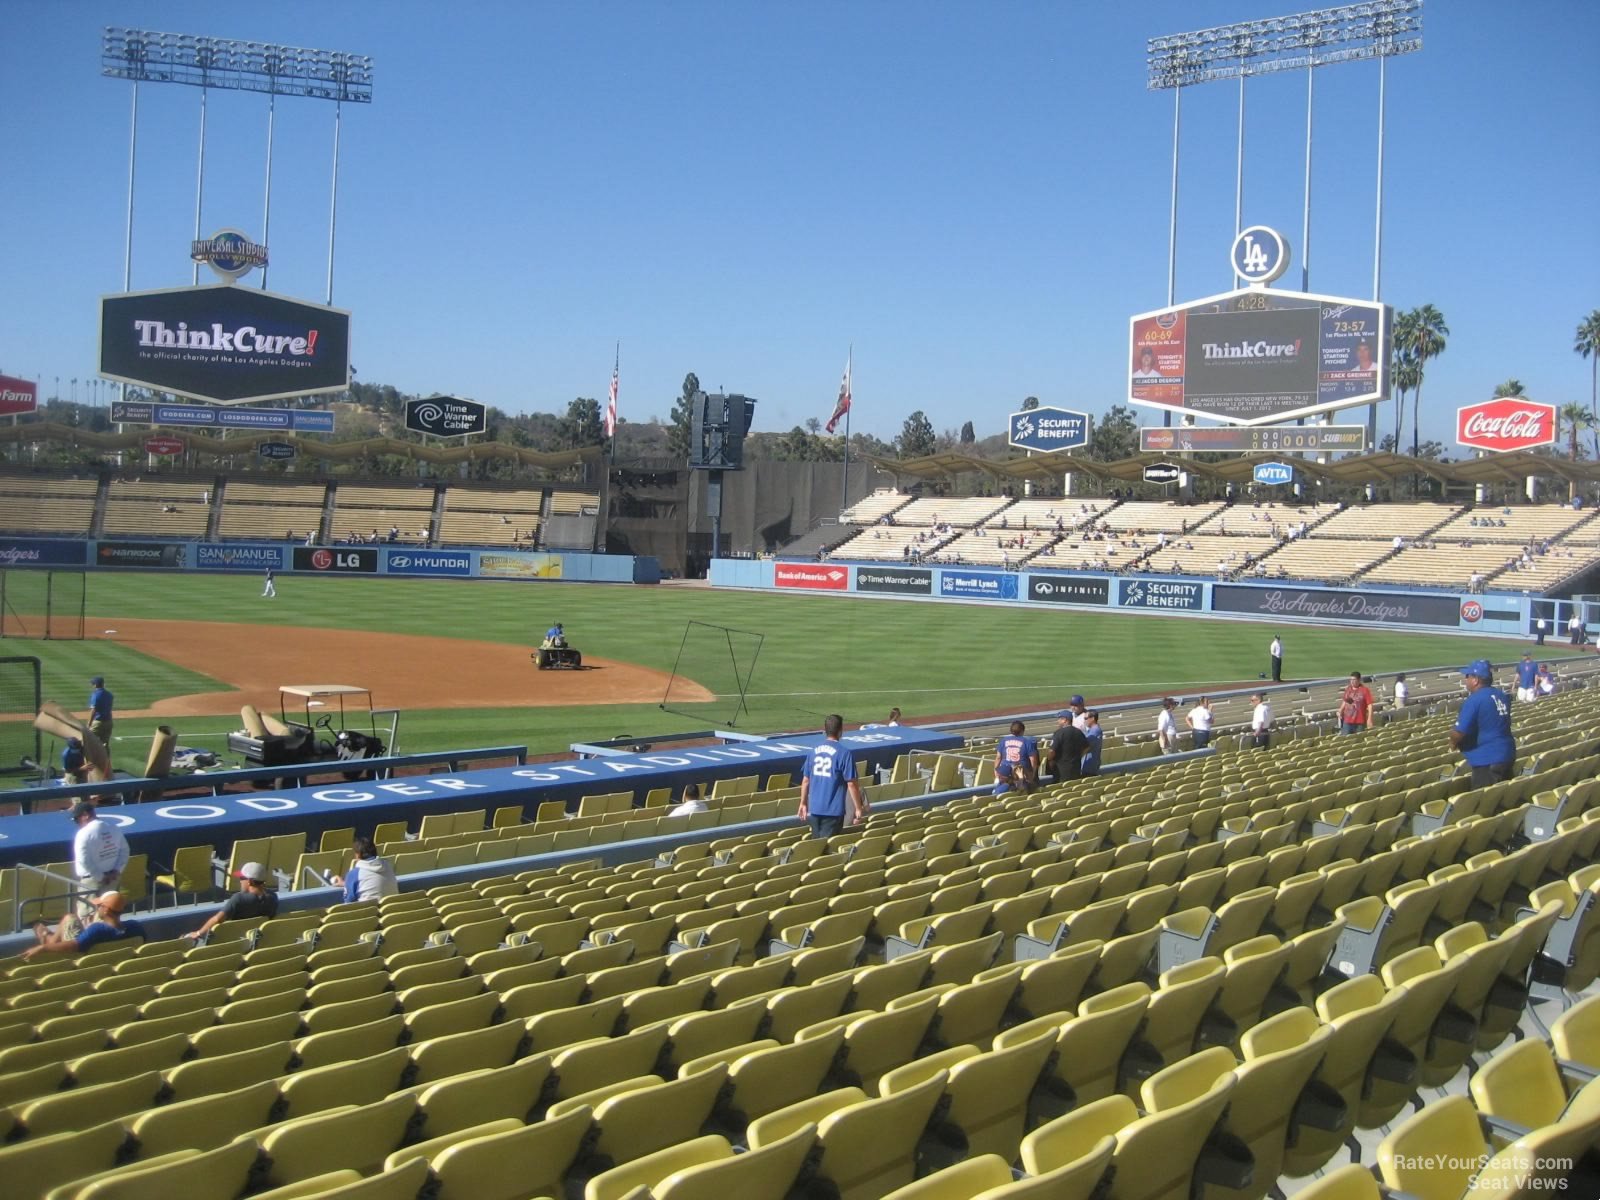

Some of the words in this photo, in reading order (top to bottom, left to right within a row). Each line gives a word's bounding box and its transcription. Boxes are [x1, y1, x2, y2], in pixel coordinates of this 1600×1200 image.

[192, 239, 235, 253] UNIVERSAL
[238, 241, 269, 259] STUDIOS
[1243, 236, 1268, 272] LA
[1238, 297, 1265, 309] 4:28
[1334, 320, 1365, 332] 73-57
[134, 319, 318, 356] ThinkCure!
[1145, 331, 1173, 340] 60-69
[1202, 338, 1302, 359] ThinkCure!
[153, 352, 181, 360] official
[182, 353, 209, 363] charity
[211, 354, 219, 362] of
[221, 355, 232, 363] the
[234, 356, 247, 364] Los
[249, 357, 278, 366] Angeles
[280, 358, 312, 368] Dodgers
[2, 389, 32, 401] Farm
[445, 404, 467, 413] Time
[444, 412, 477, 422] Warner
[1038, 418, 1082, 428] SECURITY
[443, 420, 469, 429] Cable
[1463, 411, 1546, 438] Coca-Cola
[1037, 429, 1077, 438] BENEFIT
[1321, 433, 1361, 443] SUBWAY
[1257, 468, 1288, 479] AVITA
[199, 548, 223, 558] SAN
[231, 548, 280, 560] MANUEL
[336, 553, 360, 568] LG
[414, 558, 469, 569] HYUNDAI
[777, 571, 794, 579] Bank
[801, 572, 827, 581] America
[867, 575, 884, 583] Time
[884, 576, 909, 585] Warner
[909, 577, 929, 585] Cable
[955, 578, 977, 587] Merrill
[978, 579, 998, 588] Lynch
[1147, 582, 1197, 595] SECURITY
[1055, 585, 1103, 595] INFINITI
[1146, 594, 1191, 607] BENEFIT
[1259, 590, 1285, 612] Los
[1286, 592, 1345, 616] Angeles
[1344, 595, 1410, 621] Dodgers
[1463, 604, 1480, 619] 76
[512, 742, 815, 781] STADIUM
[813, 755, 832, 778] 22
